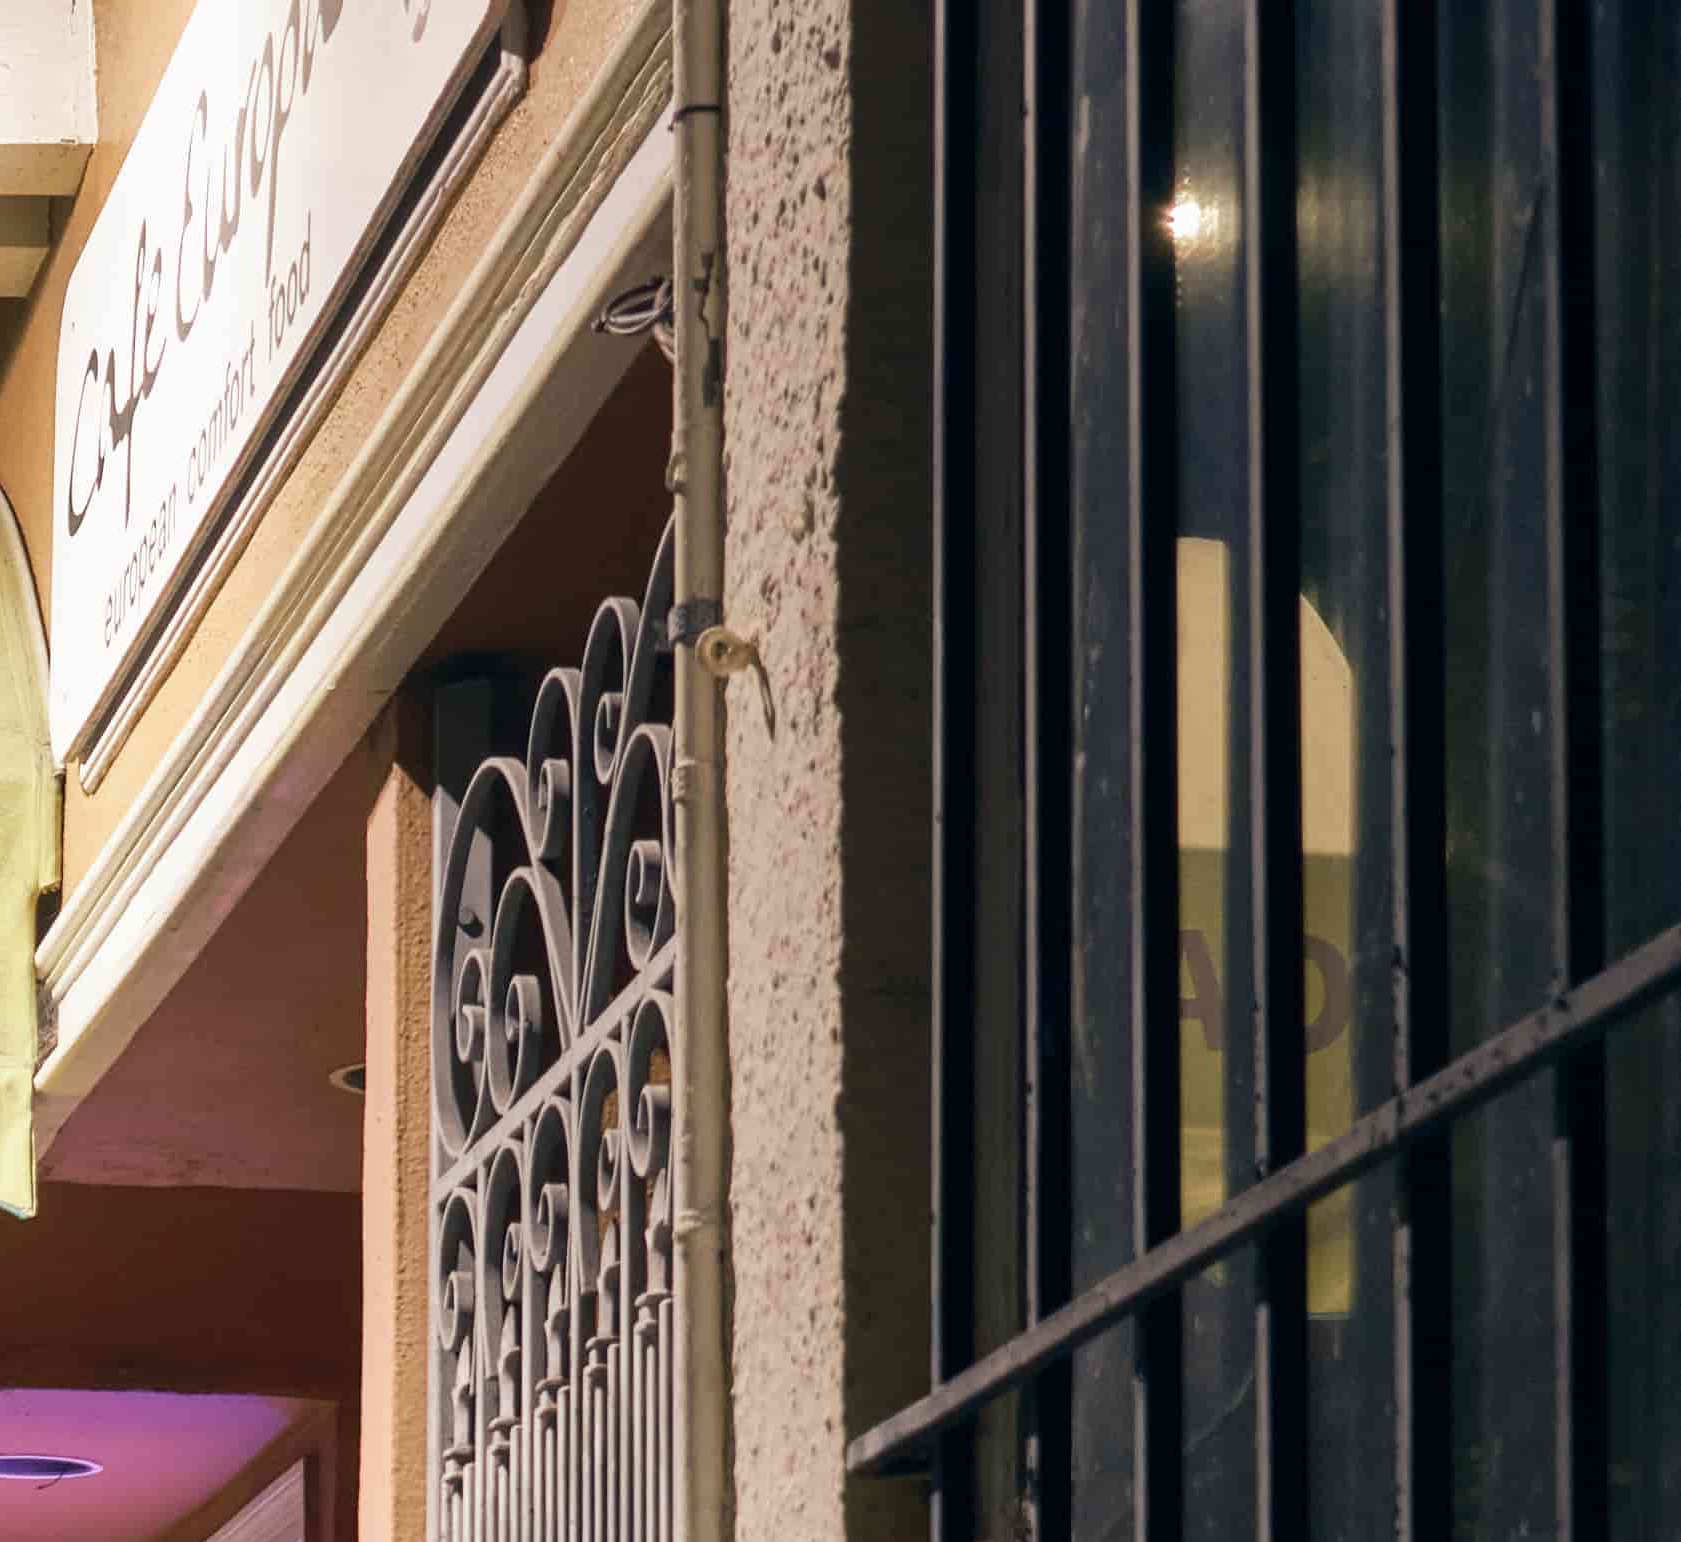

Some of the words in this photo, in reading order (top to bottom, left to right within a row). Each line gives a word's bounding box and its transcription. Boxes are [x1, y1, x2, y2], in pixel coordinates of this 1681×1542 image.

[68, 218, 167, 537] Cafe
[104, 482, 177, 648] european
[186, 319, 256, 505] comfort
[268, 208, 312, 362] food
